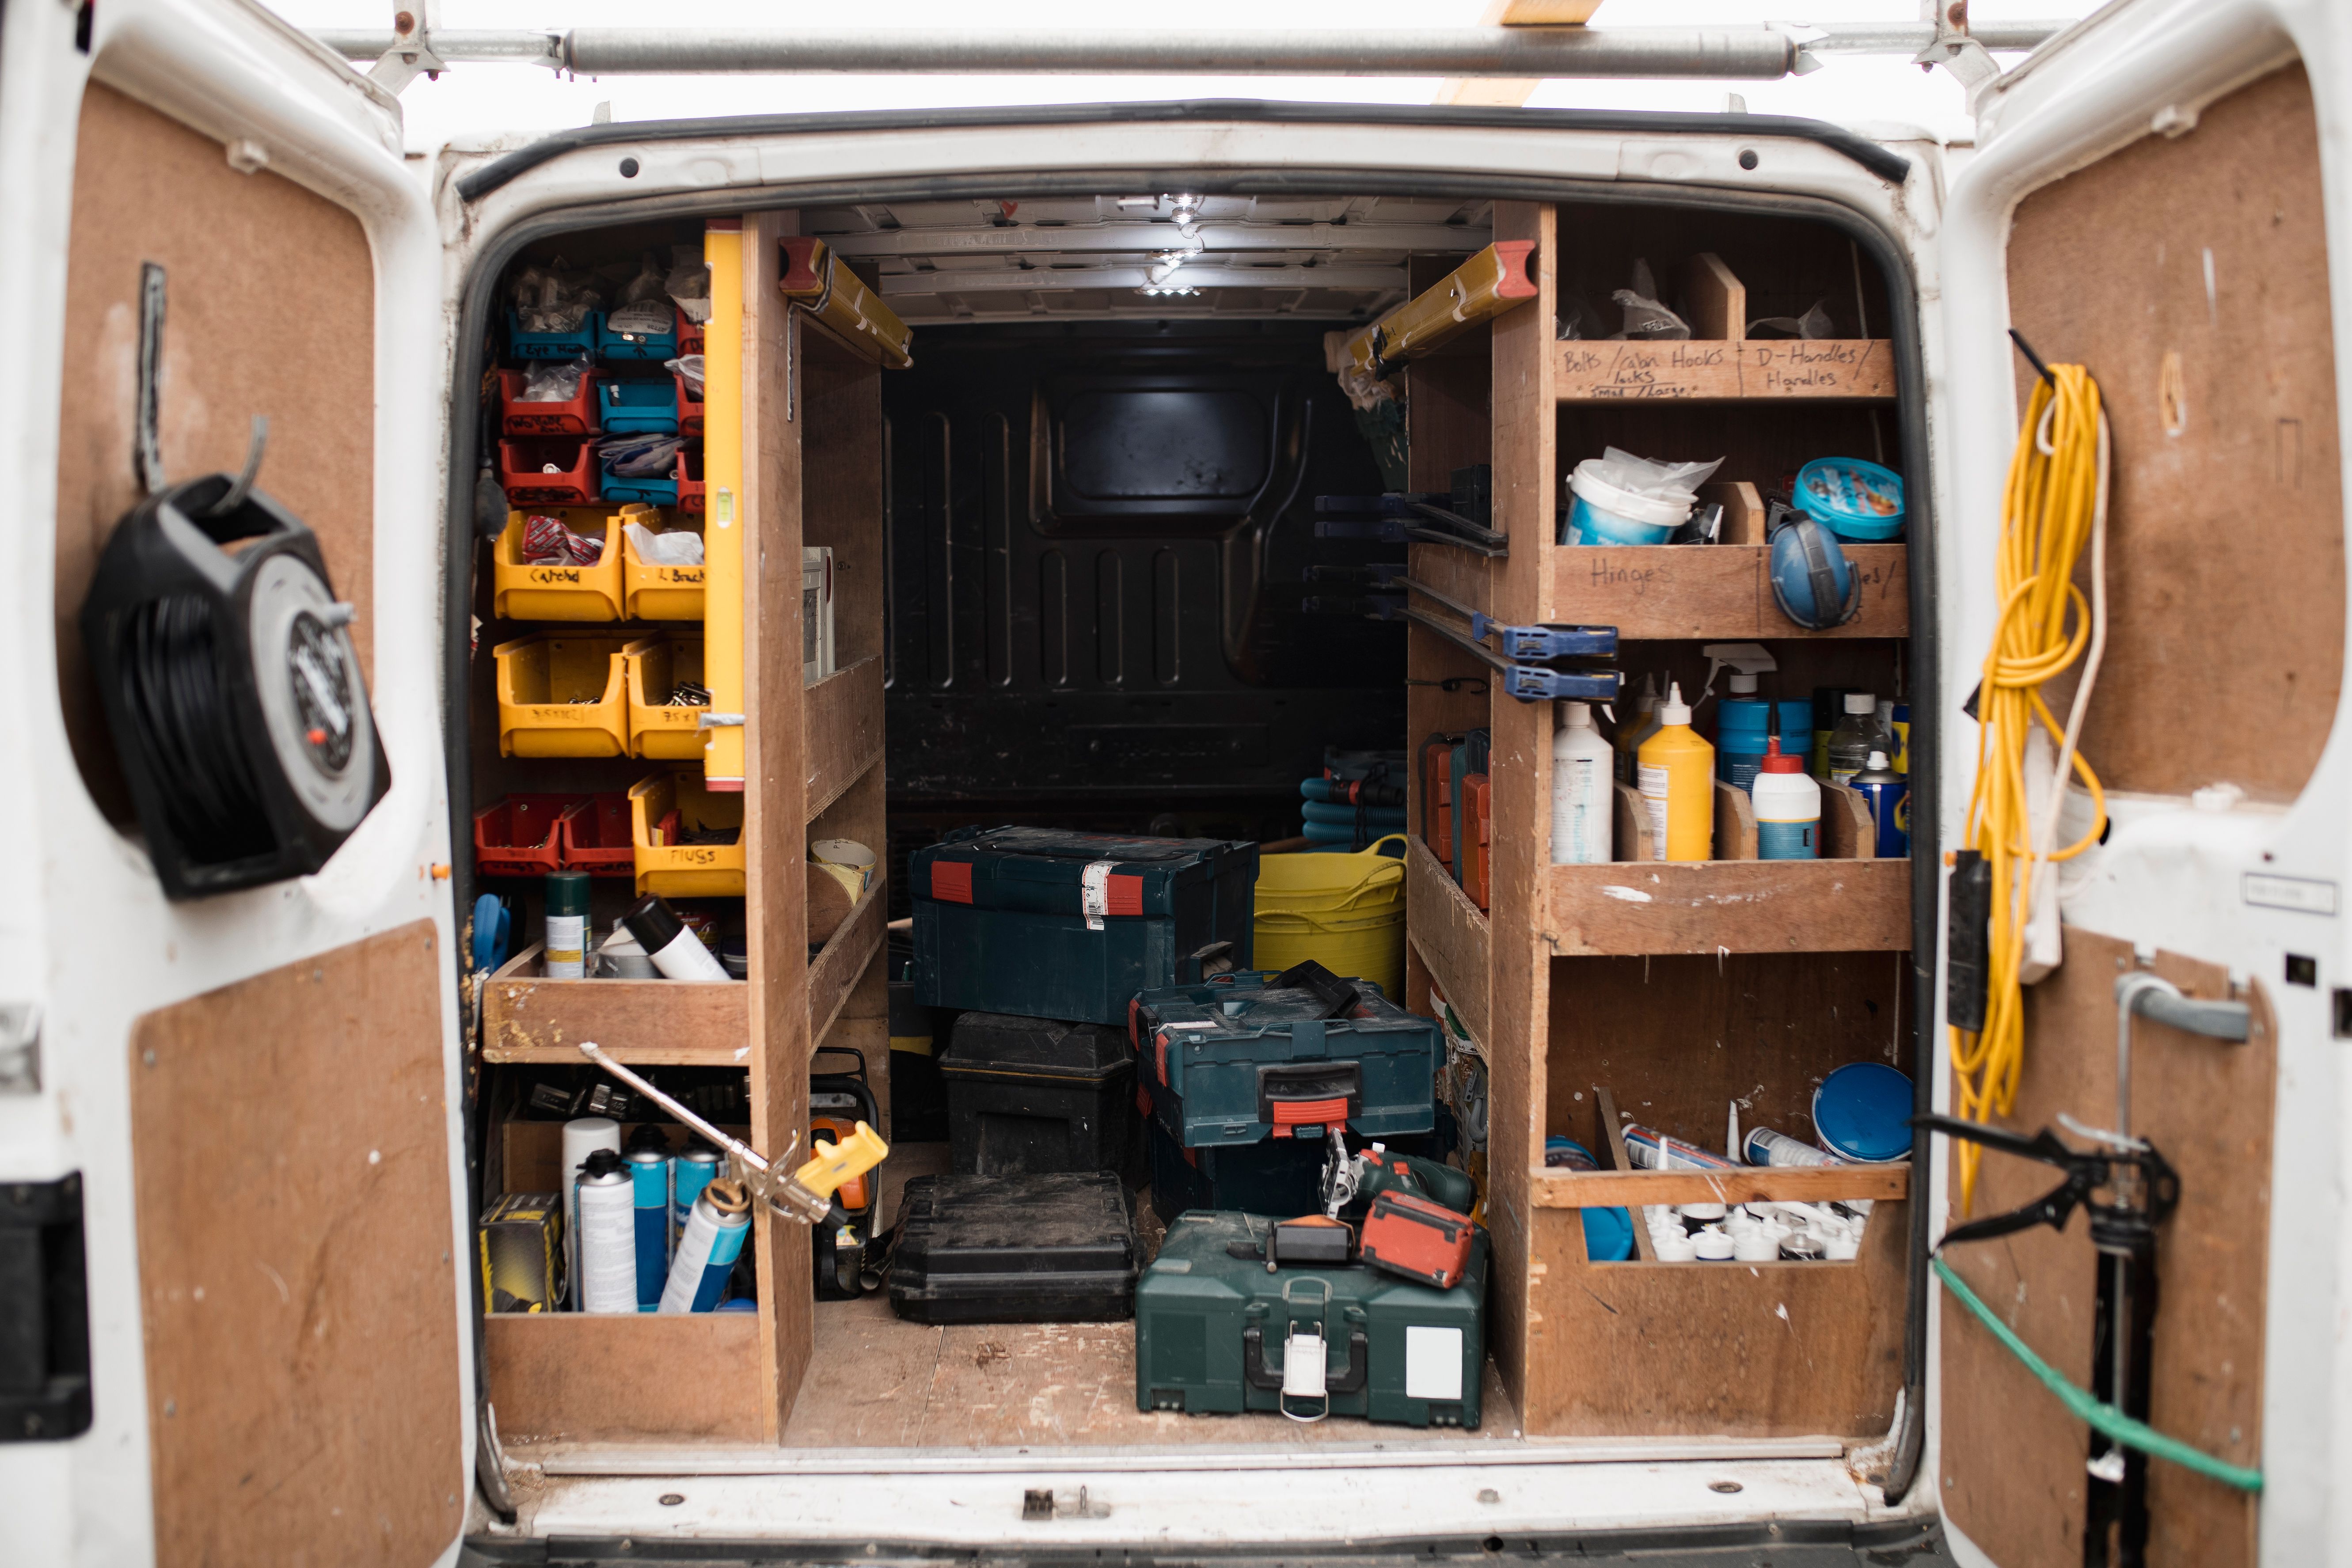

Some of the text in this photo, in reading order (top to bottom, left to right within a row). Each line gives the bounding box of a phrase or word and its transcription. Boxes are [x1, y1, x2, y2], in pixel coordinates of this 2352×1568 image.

[1672, 345, 1723, 368] Hooks
[1767, 368, 1837, 389] Handles
[1591, 558, 1675, 595] Hinges
